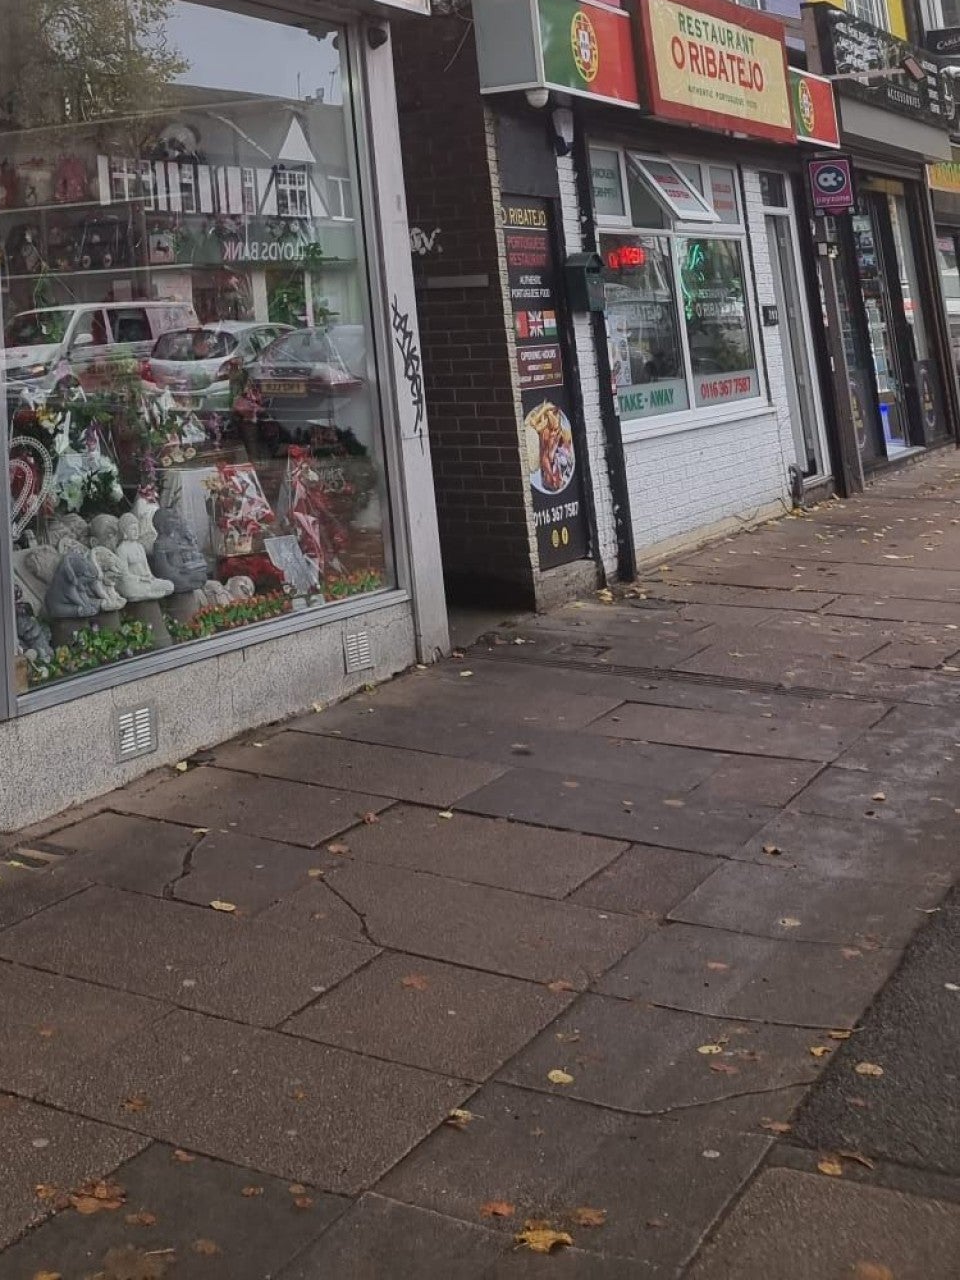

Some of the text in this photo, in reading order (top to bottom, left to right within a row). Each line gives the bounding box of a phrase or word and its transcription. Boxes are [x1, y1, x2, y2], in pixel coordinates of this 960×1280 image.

[678, 11, 755, 57] RESTAURANT
[671, 35, 764, 93] O RIBATEJO
[508, 207, 546, 226] RIBATEJO
[700, 376, 751, 401] 0116 367 7587
